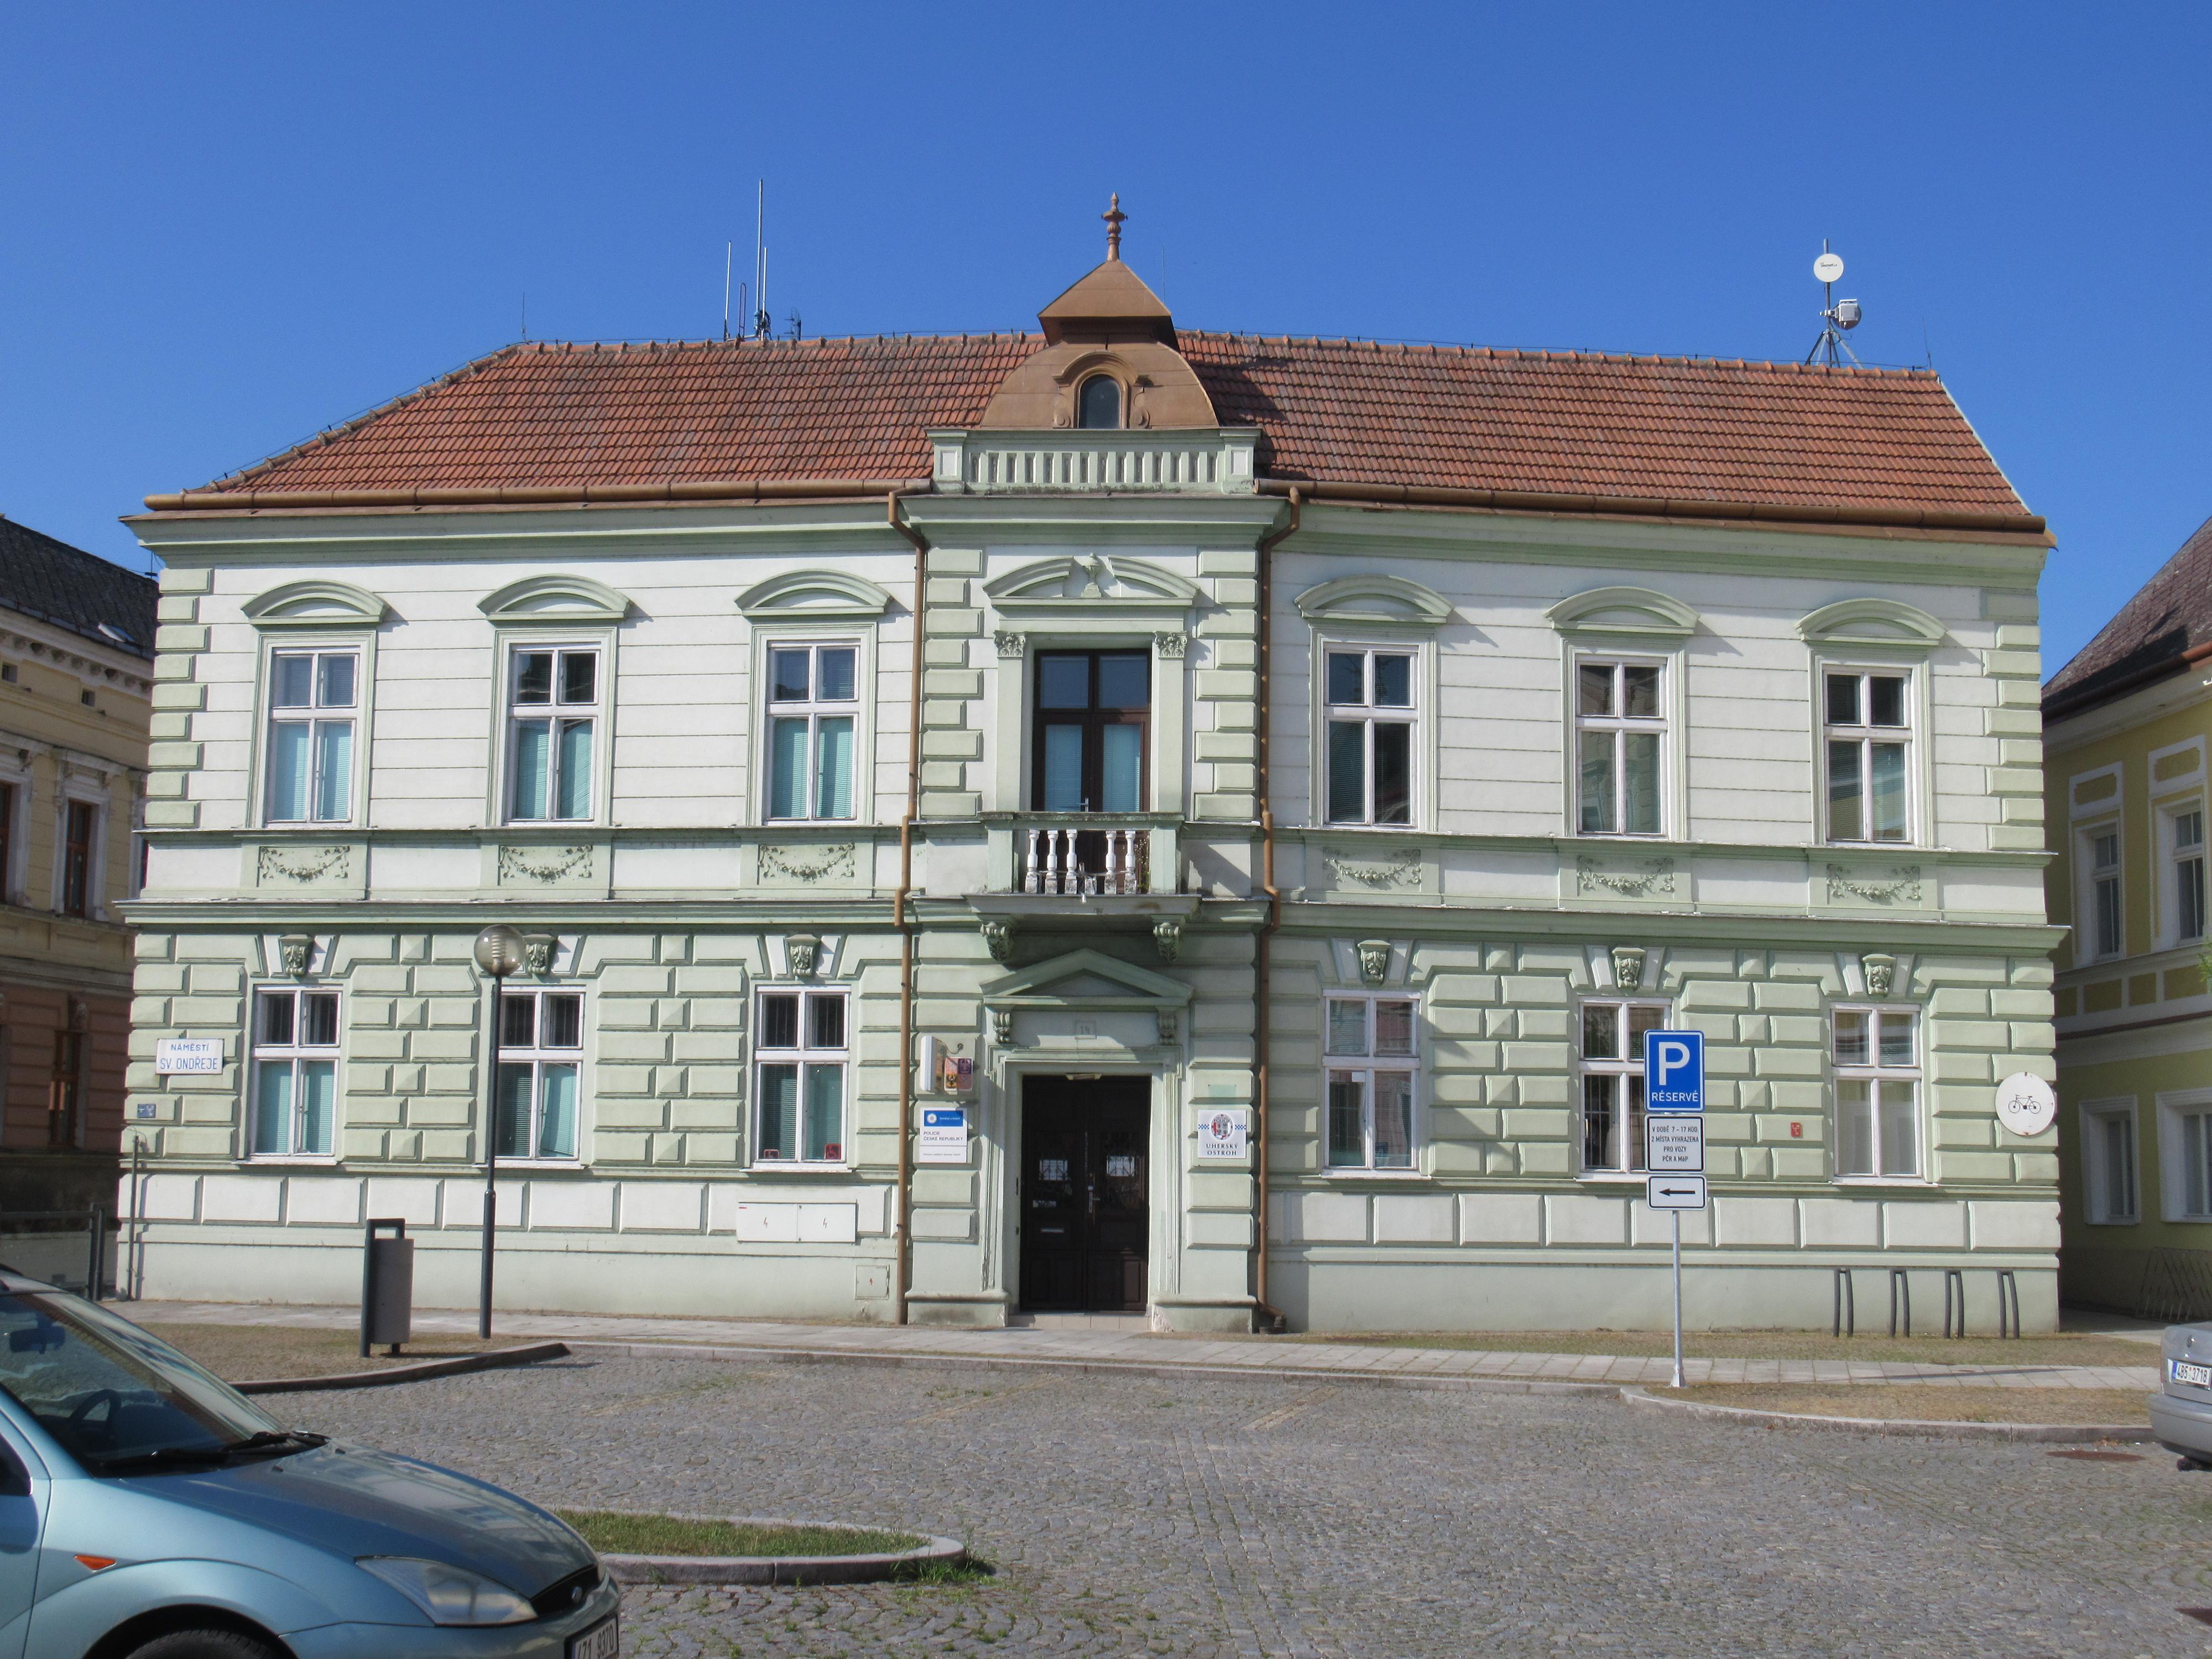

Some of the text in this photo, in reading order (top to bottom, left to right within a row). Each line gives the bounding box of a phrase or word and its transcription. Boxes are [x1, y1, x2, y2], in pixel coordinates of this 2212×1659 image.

[171, 1043, 210, 1051] NÁMĚSTÍ
[160, 1056, 218, 1070] SV. ONDŘEJE
[1658, 1042, 1690, 1086] P
[1651, 1089, 1698, 1102] RÉSERVÉ
[2192, 1367, 2208, 1383] 3718
